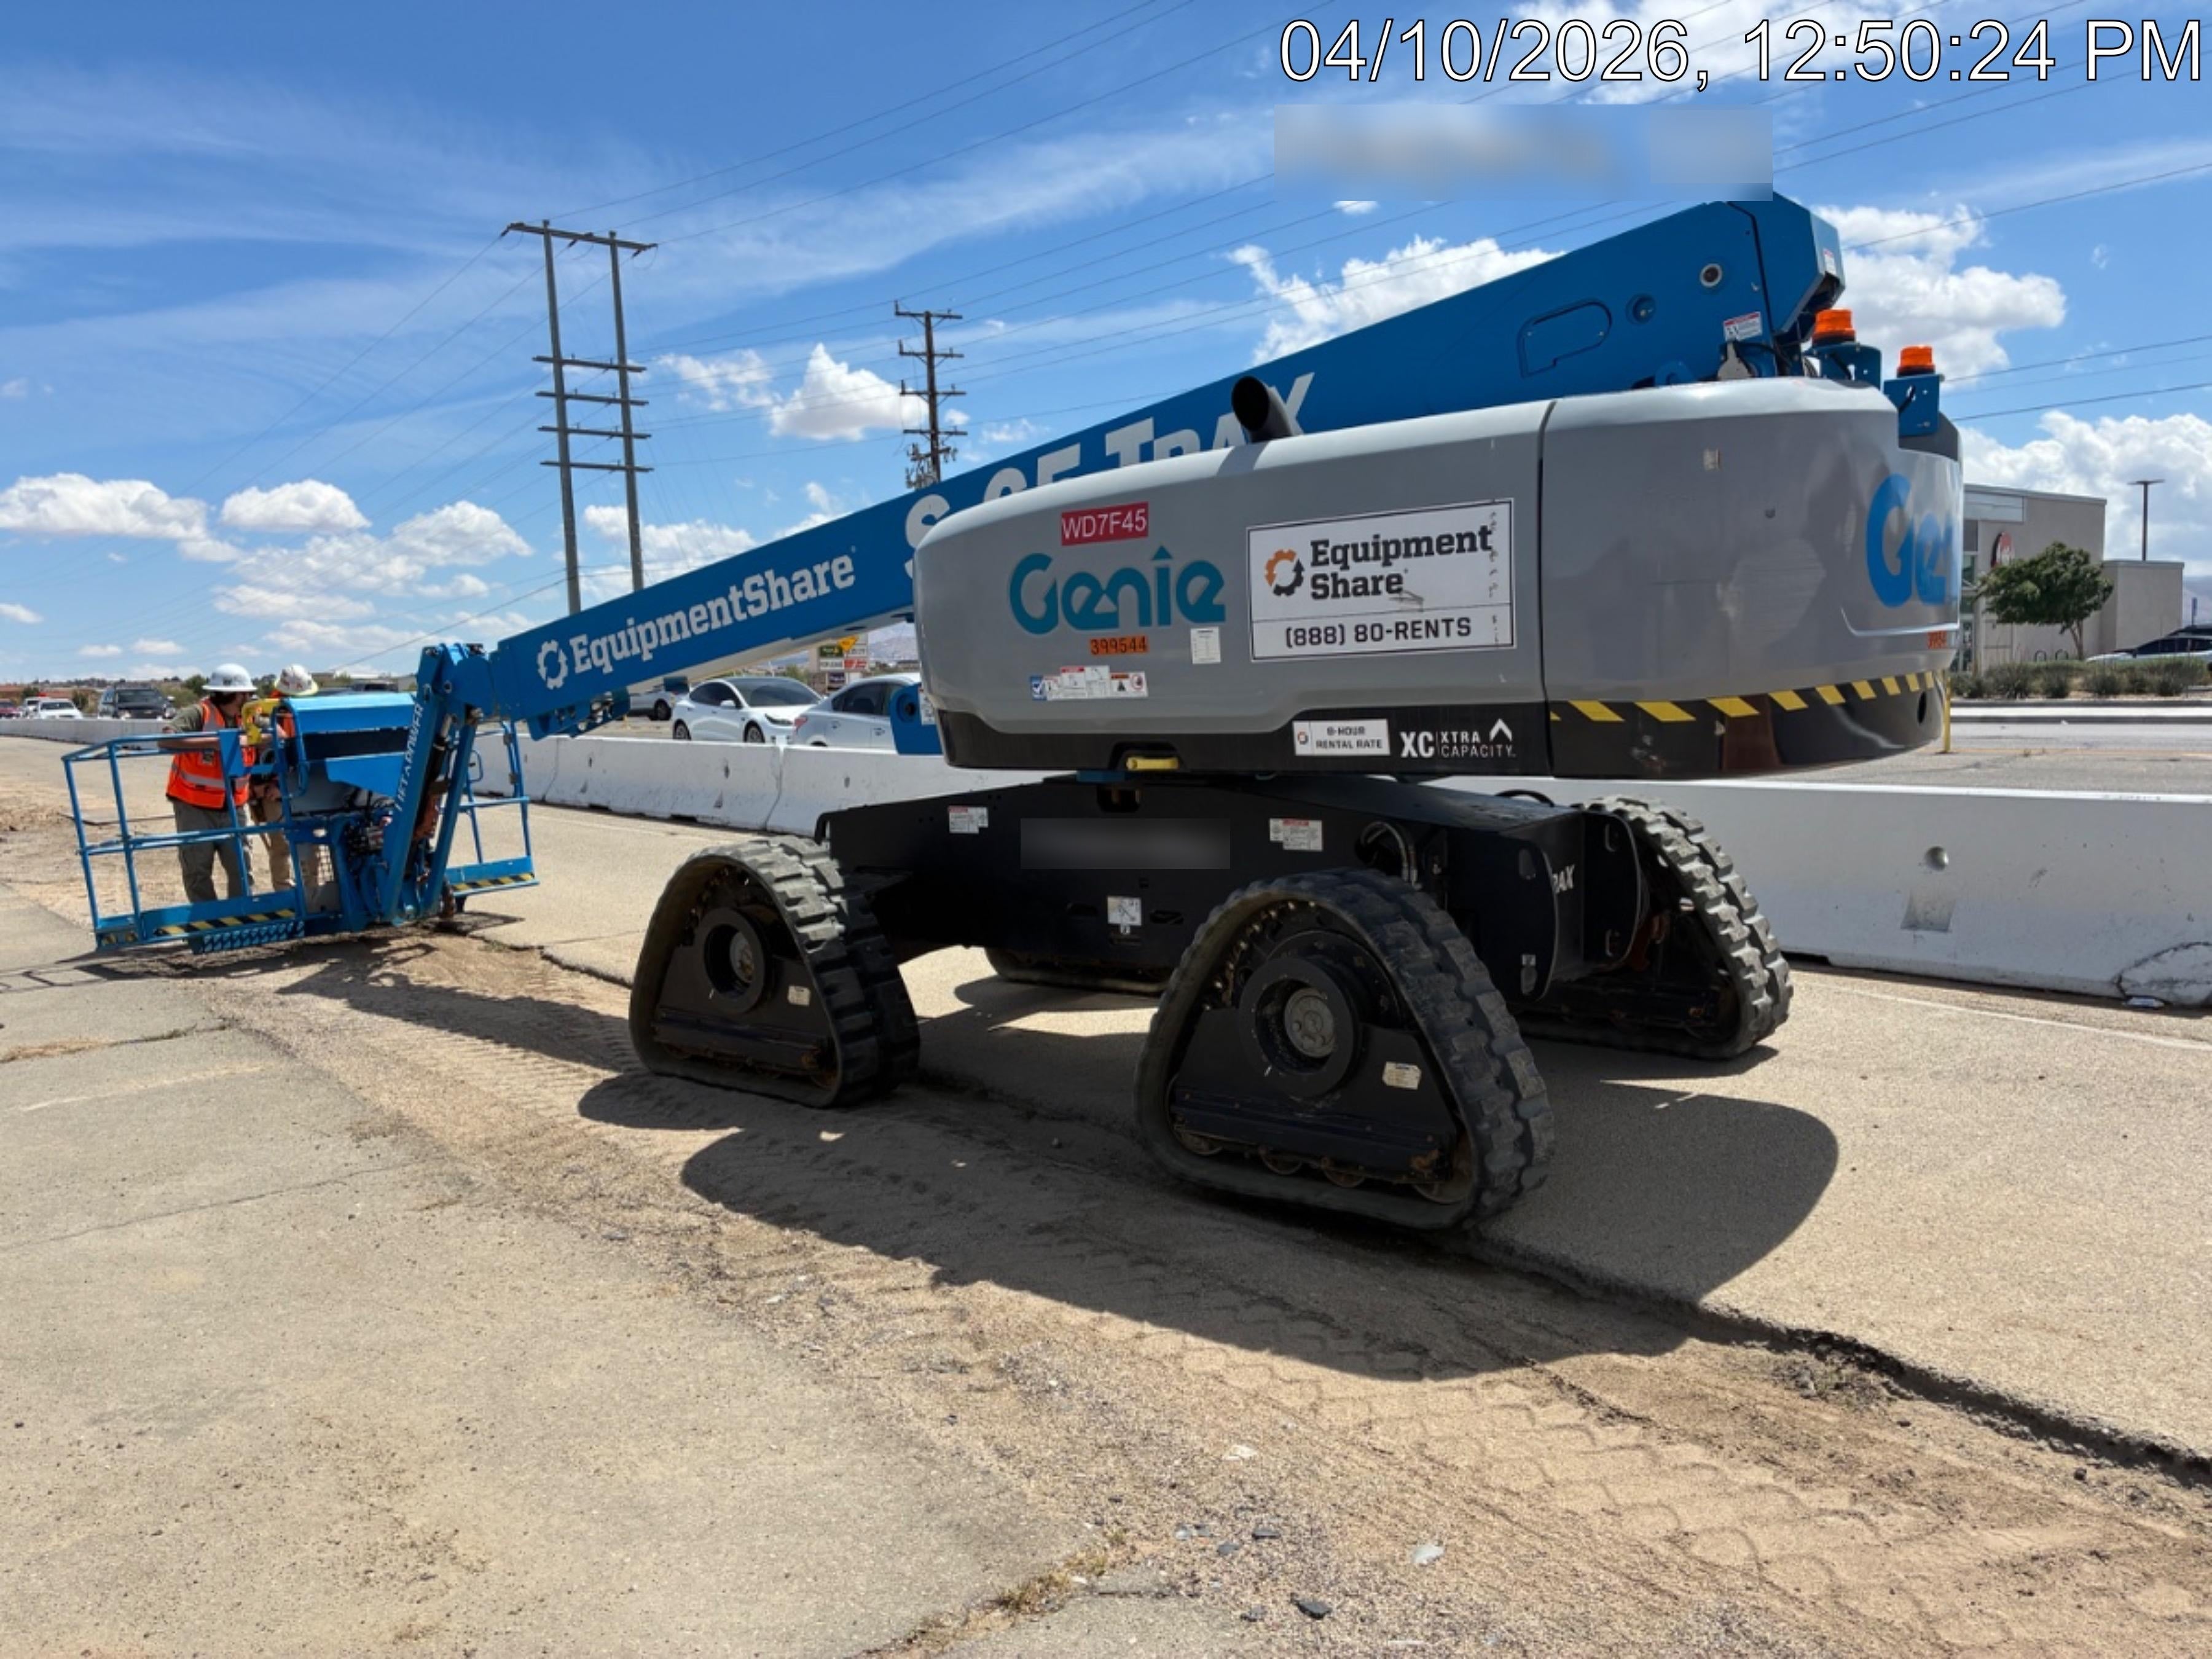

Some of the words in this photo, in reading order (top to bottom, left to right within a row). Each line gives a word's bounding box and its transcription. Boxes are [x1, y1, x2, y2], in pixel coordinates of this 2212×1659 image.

[1062, 508, 1147, 540] WD7F45
[1310, 525, 1492, 571] Equipment
[1010, 545, 1226, 635] Genie
[1310, 572, 1403, 600] Share
[570, 554, 855, 675] EquipmentShare
[1090, 636, 1147, 656] 399544
[1285, 623, 1345, 648] (888)
[1354, 617, 1472, 643] 80-RENTS
[1316, 739, 1354, 749] RENTAL
[1357, 739, 1382, 748] RATE
[1400, 731, 1435, 758] XC
[1440, 731, 1481, 744] XTRA
[1441, 744, 1513, 758] CAPACITY
